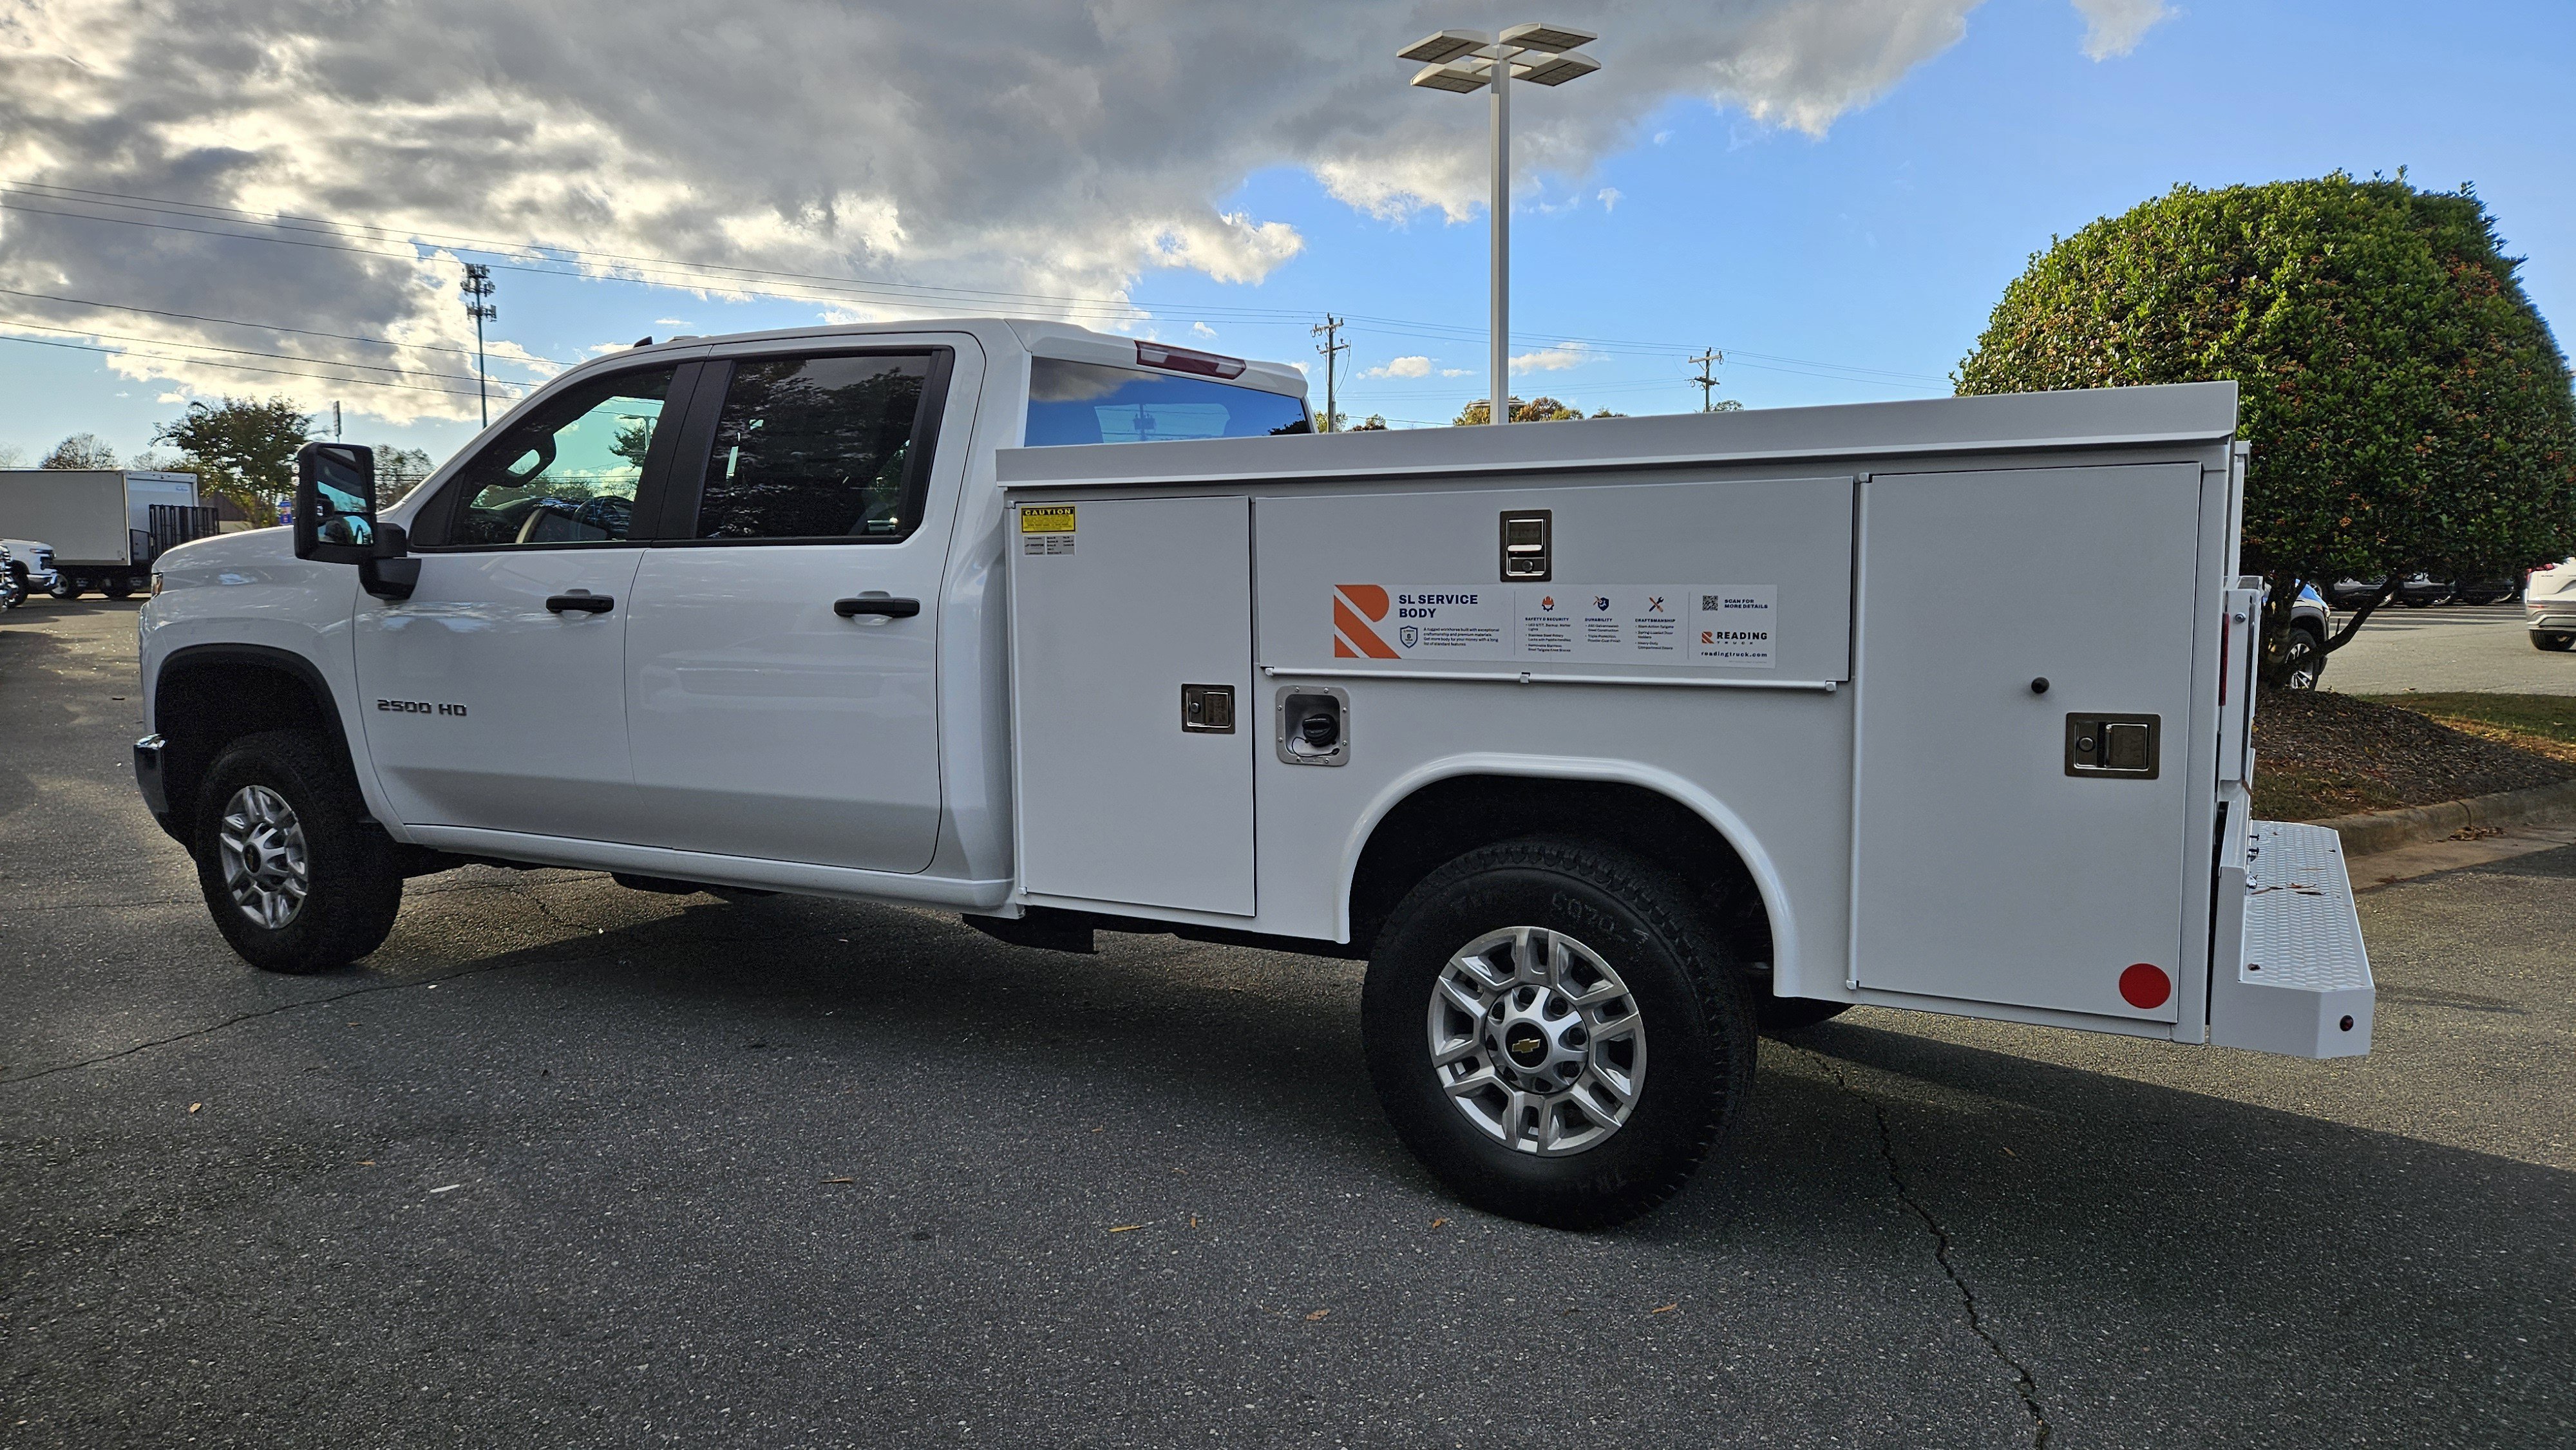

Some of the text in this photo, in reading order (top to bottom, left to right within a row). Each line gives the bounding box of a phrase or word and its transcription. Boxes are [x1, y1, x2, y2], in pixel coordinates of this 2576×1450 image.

[1399, 594, 1478, 605] SL SERVICE
[1399, 608, 1437, 618] BODY
[1717, 631, 1767, 640] READING
[377, 699, 468, 716] 2500 HD
